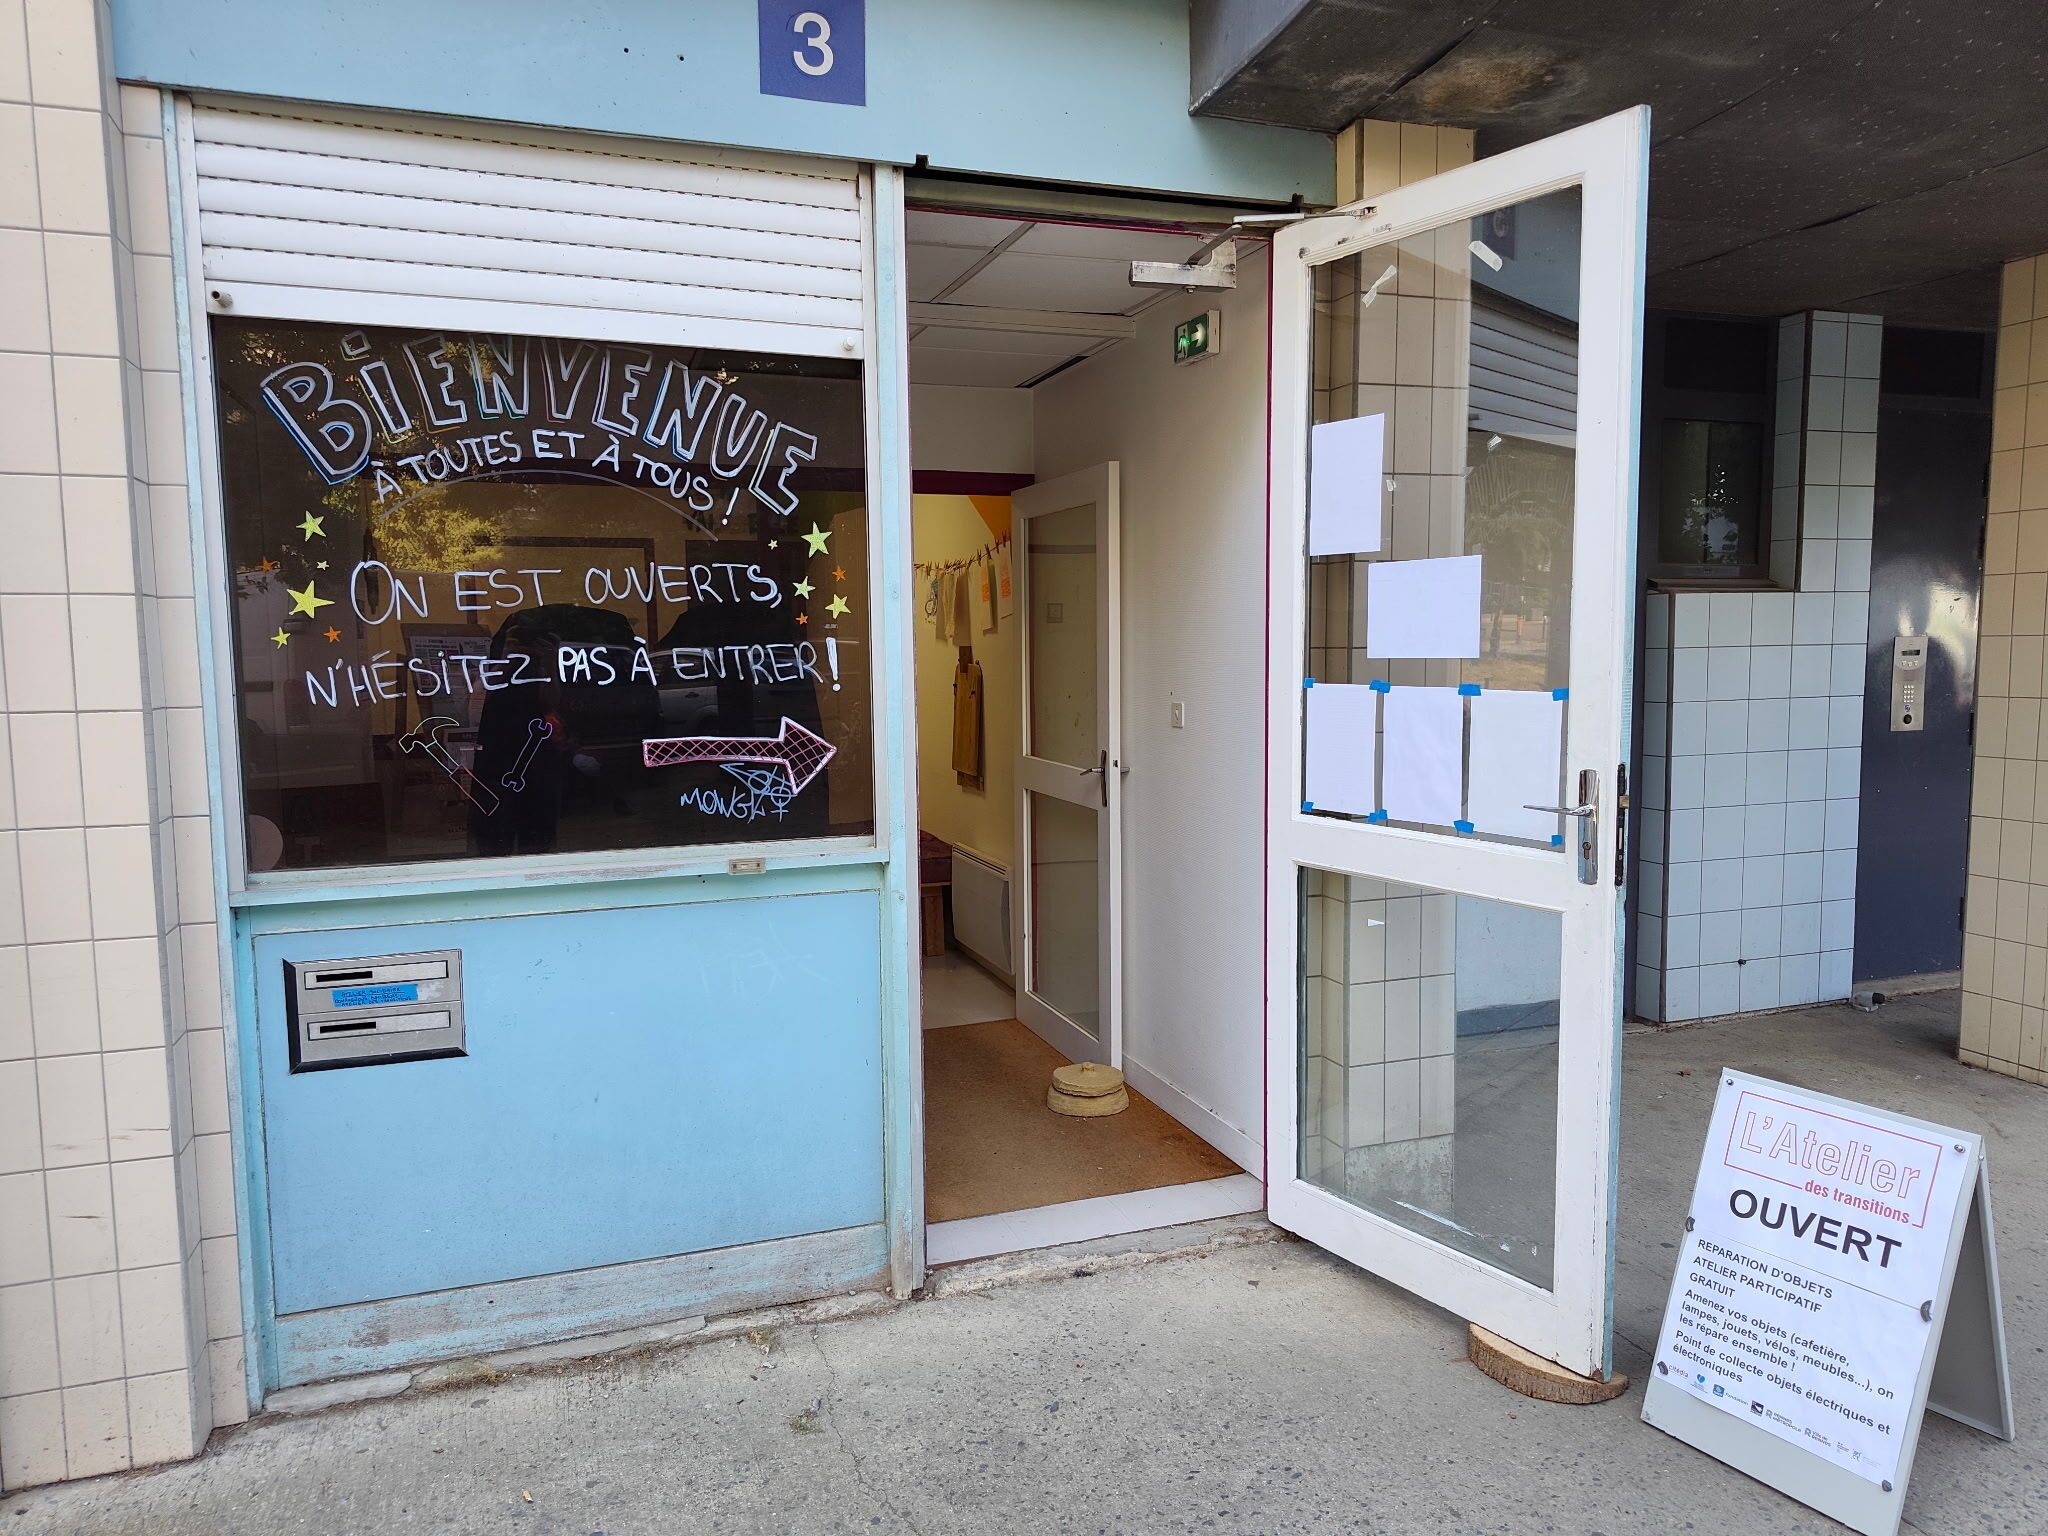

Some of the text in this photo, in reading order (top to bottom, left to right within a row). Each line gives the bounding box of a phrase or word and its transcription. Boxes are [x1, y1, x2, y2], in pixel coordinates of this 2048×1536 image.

[793, 12, 834, 76] 3
[369, 460, 404, 504] À
[397, 431, 522, 485] TOUTES
[532, 428, 585, 459] ET
[591, 433, 621, 473] À
[351, 560, 783, 625] ON EST OUVERTS,
[558, 646, 617, 686] PAS
[631, 635, 658, 687] À
[1740, 1111, 1921, 1199] L'Atelier
[1729, 1189, 1903, 1269] OUVERT
[1804, 1179, 1911, 1224] des transitions
[1689, 1272, 1736, 1298] GRATUIT
[1693, 1256, 1823, 1313] ATELIER PARTICIPATIF
[1698, 1238, 1833, 1300] REPARATION D'OBJETS
[1679, 1313, 1796, 1372] les répare ensemble !
[1682, 1301, 1720, 1326] lampes,
[1722, 1319, 1761, 1344] jouets,
[1765, 1338, 1799, 1361] vélos,
[1877, 1387, 1894, 1400] on
[1685, 1289, 1850, 1367] Amenez vos objets (cafetière,
[1673, 1343, 1743, 1383] électroniques
[1675, 1329, 1891, 1435] Point de collecte objets électriques et
